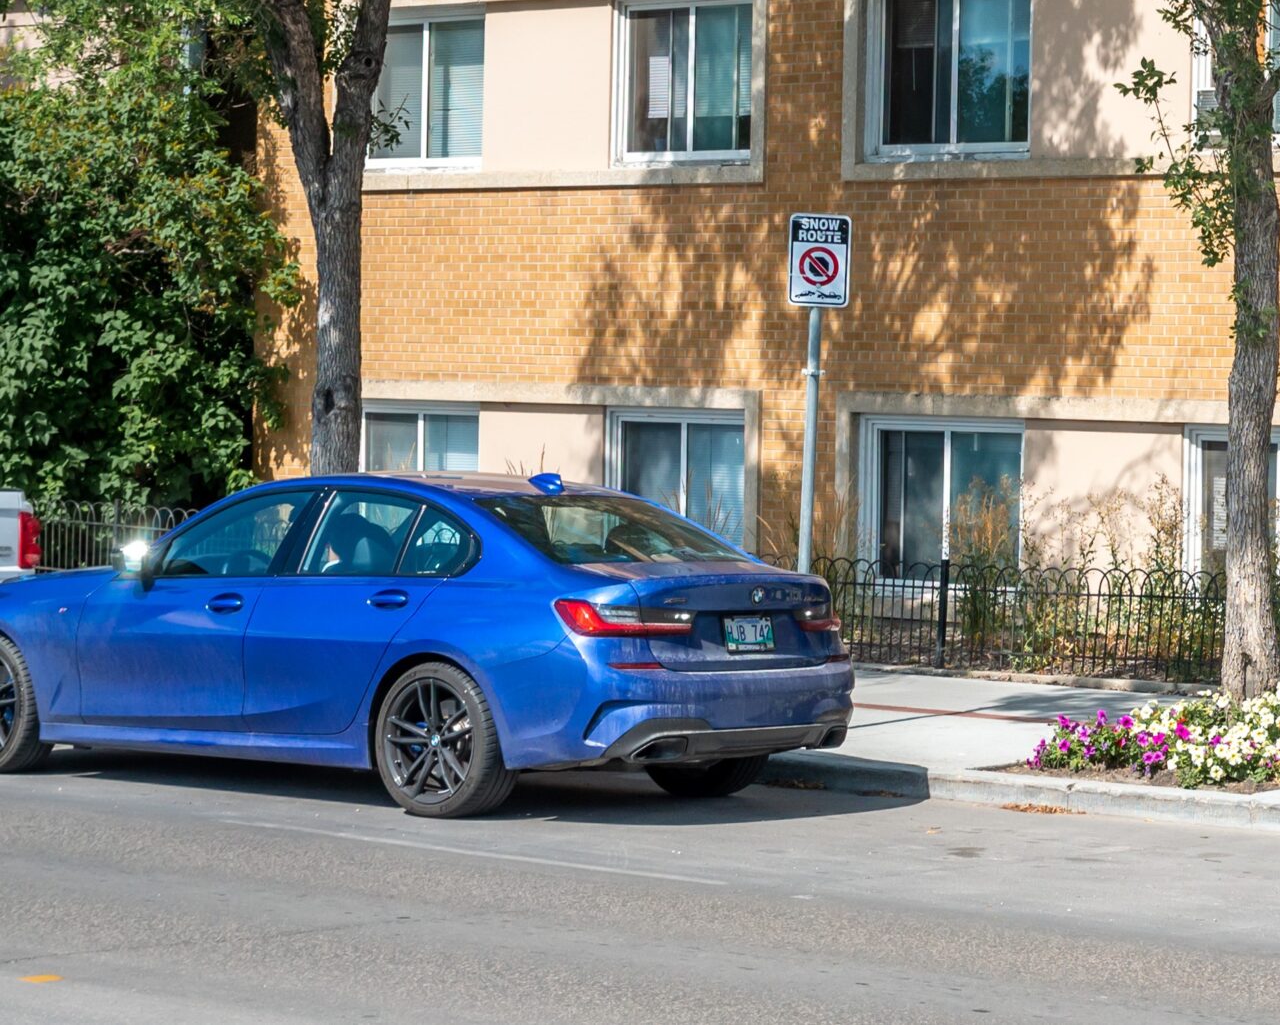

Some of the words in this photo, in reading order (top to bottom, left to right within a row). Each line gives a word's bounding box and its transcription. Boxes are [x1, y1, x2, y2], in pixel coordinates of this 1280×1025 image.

[801, 218, 840, 230] SNOW
[798, 230, 842, 242] ROUTE
[726, 624, 746, 641] HJB
[751, 624, 772, 641] 742
